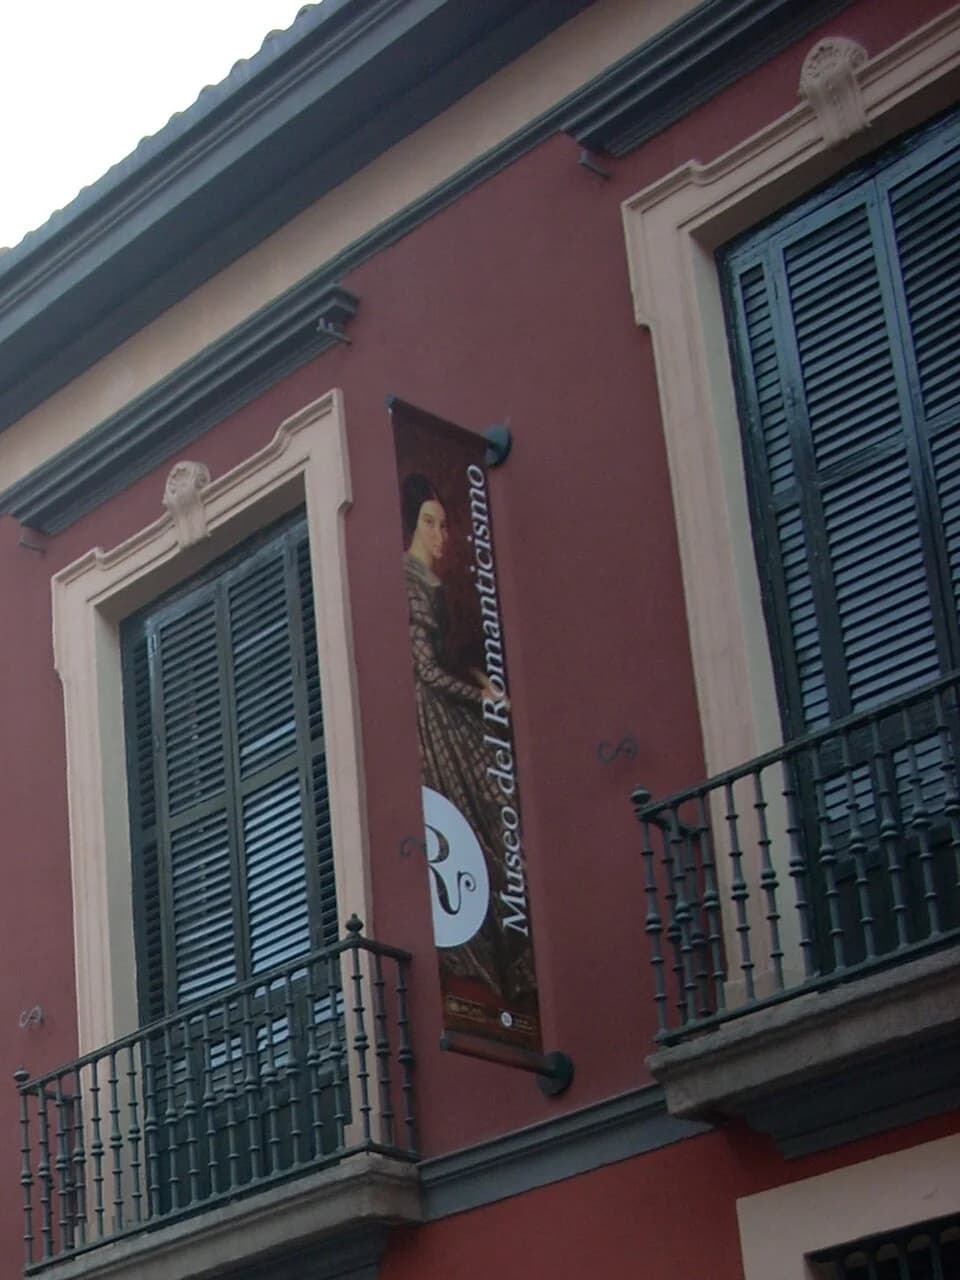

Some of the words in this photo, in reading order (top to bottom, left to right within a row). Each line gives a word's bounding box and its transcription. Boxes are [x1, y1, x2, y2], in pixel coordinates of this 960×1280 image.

[467, 464, 510, 727] Romanticismo
[483, 735, 514, 795] del
[499, 805, 529, 937] Museo
